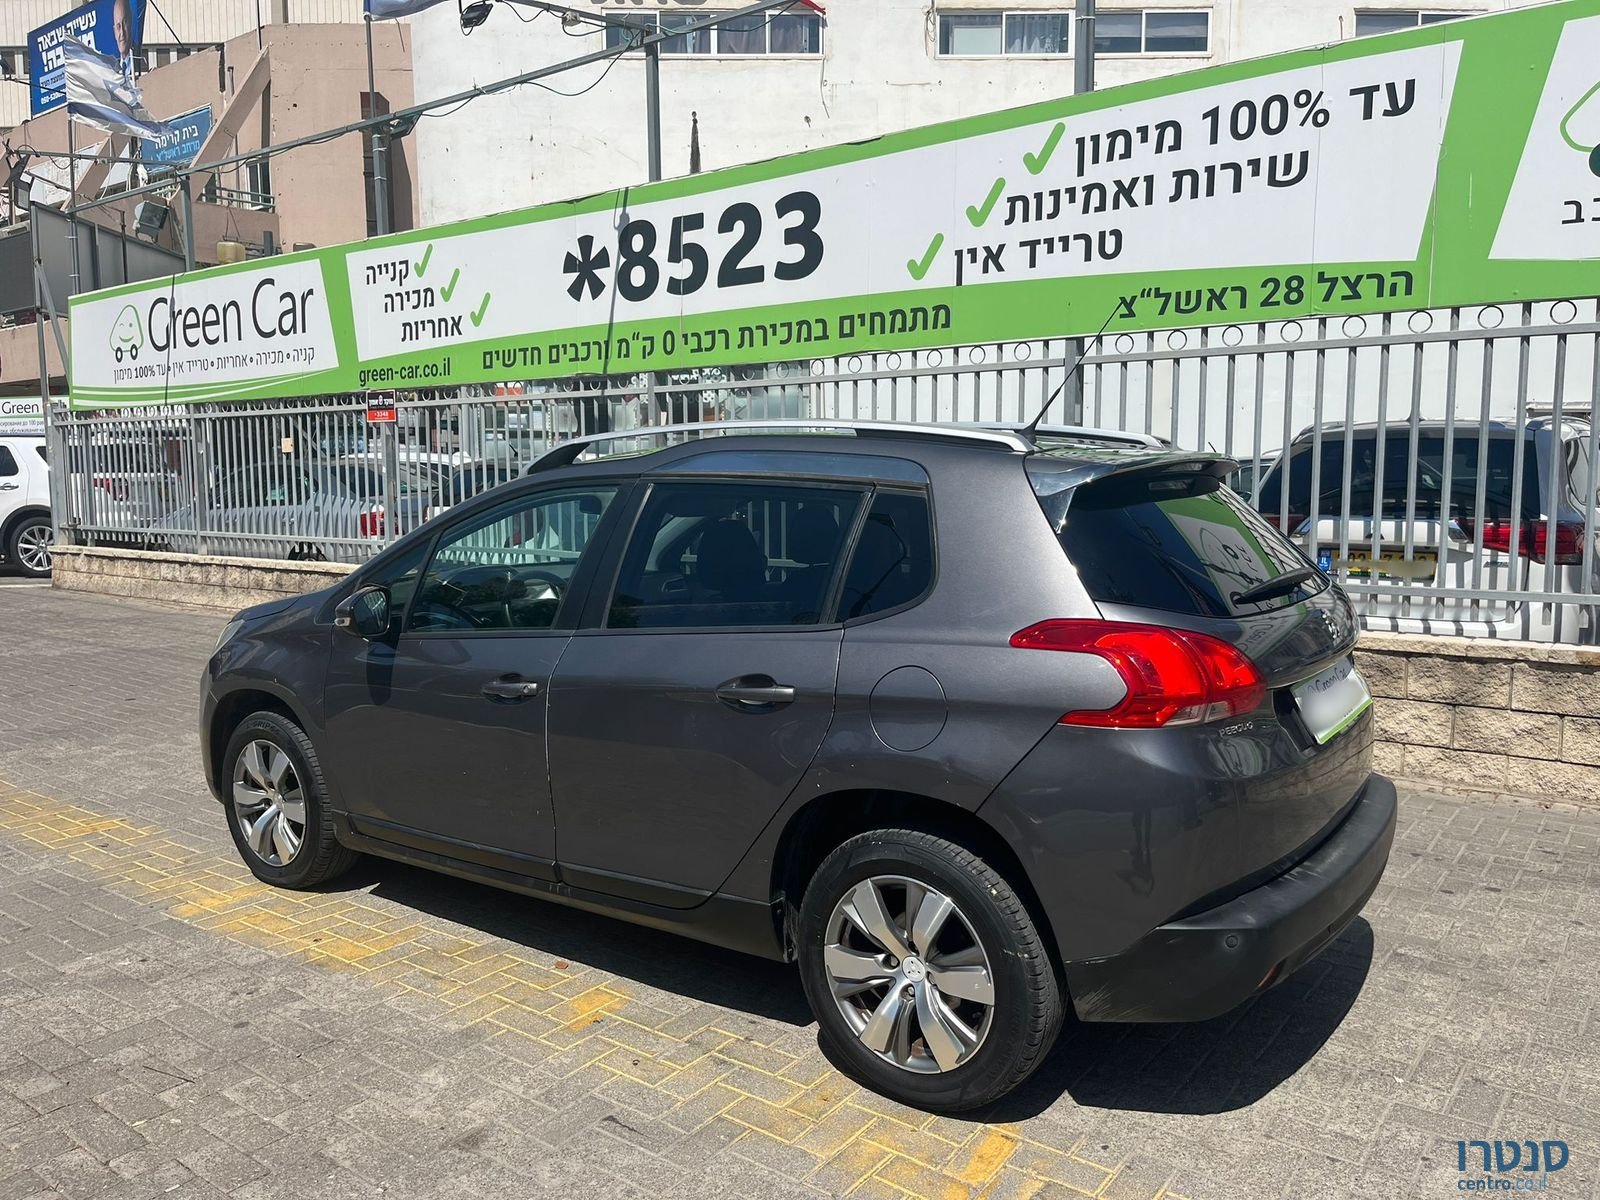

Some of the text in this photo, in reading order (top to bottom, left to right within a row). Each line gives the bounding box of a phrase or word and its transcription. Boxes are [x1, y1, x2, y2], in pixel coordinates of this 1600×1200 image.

[182, 125, 199, 140] בית
[1075, 78, 1416, 177] עד 100% מימון
[1004, 149, 1310, 226] שירות ואמינות
[954, 228, 1123, 286] טרייד אין
[366, 260, 409, 286] קנייה
[1316, 269, 1414, 302] הרצל
[384, 287, 435, 313] מכירה
[1259, 276, 1305, 308] 28
[149, 278, 314, 352] Green Car
[401, 315, 463, 342] אחריות
[838, 303, 951, 339] מתמחים
[662, 330, 675, 356] 0
[682, 328, 730, 354] רכבי
[737, 318, 829, 349] במכירת
[114, 347, 315, 384] קניה מכירה אחריות טרייד אין עד 100% מימון
[482, 346, 541, 370] חדשים
[548, 340, 609, 364] ורכבים
[359, 357, 450, 387] green-car.co.il
[1, 401, 39, 415] Green
